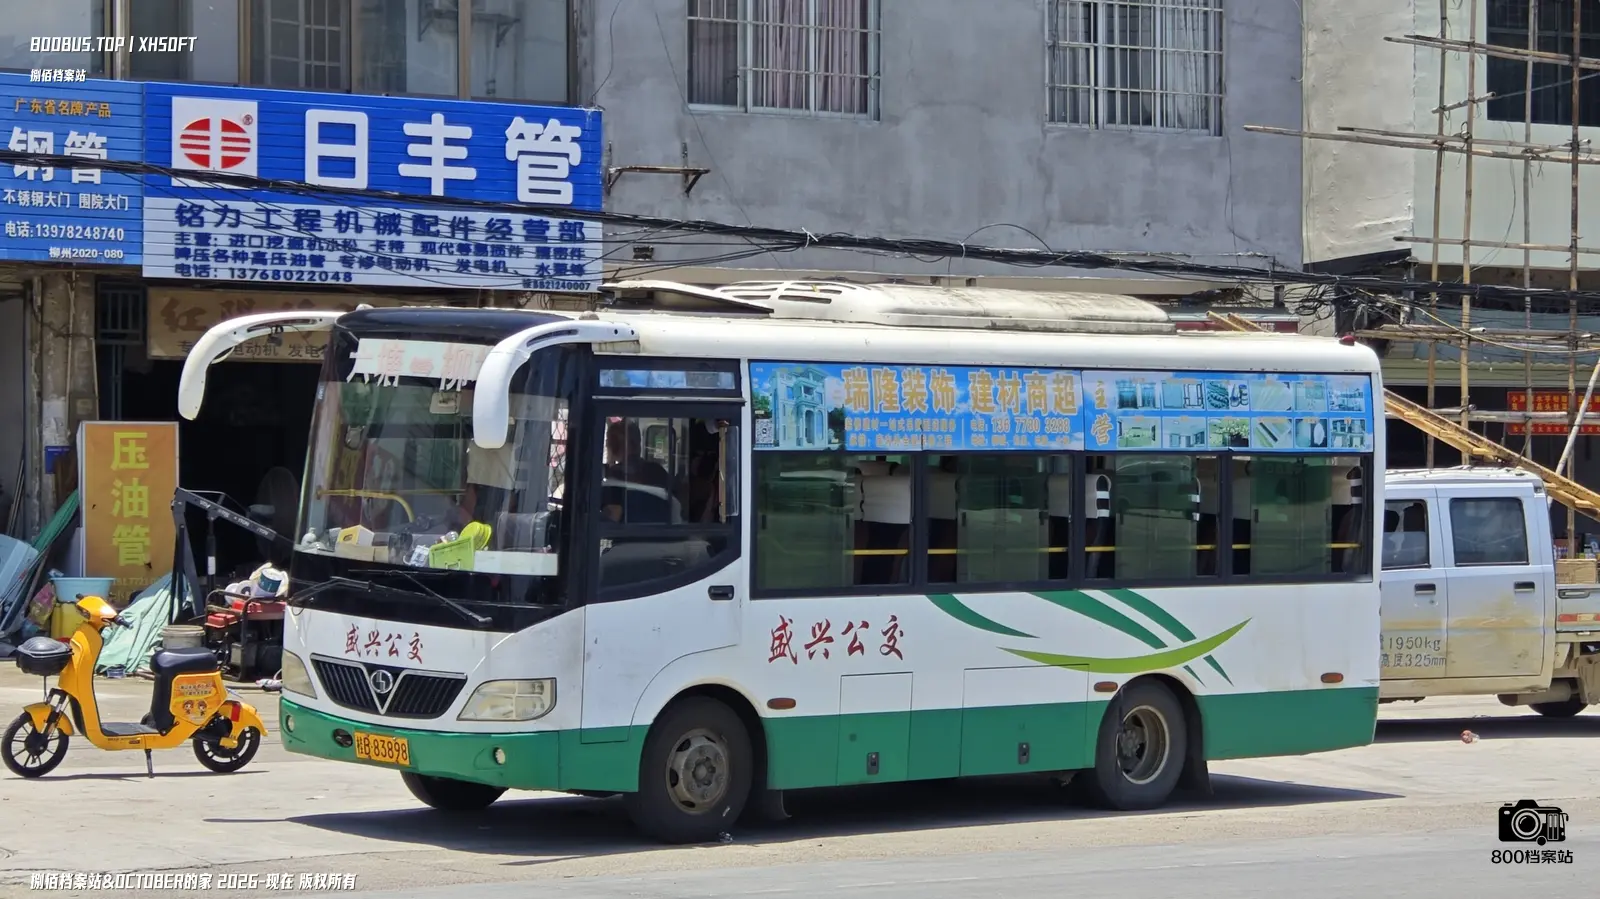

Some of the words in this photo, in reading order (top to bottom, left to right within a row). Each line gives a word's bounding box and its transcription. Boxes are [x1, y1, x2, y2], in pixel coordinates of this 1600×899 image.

[15, 98, 112, 117] 广东省名牌产品
[8, 126, 108, 184] 钢管
[304, 108, 582, 205] 日丰管
[3, 188, 70, 208] 不锈钢大门
[79, 193, 129, 211] 围院大门
[5, 220, 124, 242] 电话:13978248740
[174, 202, 586, 243] 铭力工程机械配件经营部
[49, 246, 124, 259] 柳州2020-080
[841, 366, 957, 414] 瑞隆装饰
[968, 370, 1078, 416] 建材商超
[110, 432, 151, 567] 压油管
[345, 623, 424, 665] 盛兴公交
[768, 614, 905, 665] 盛兴公交
